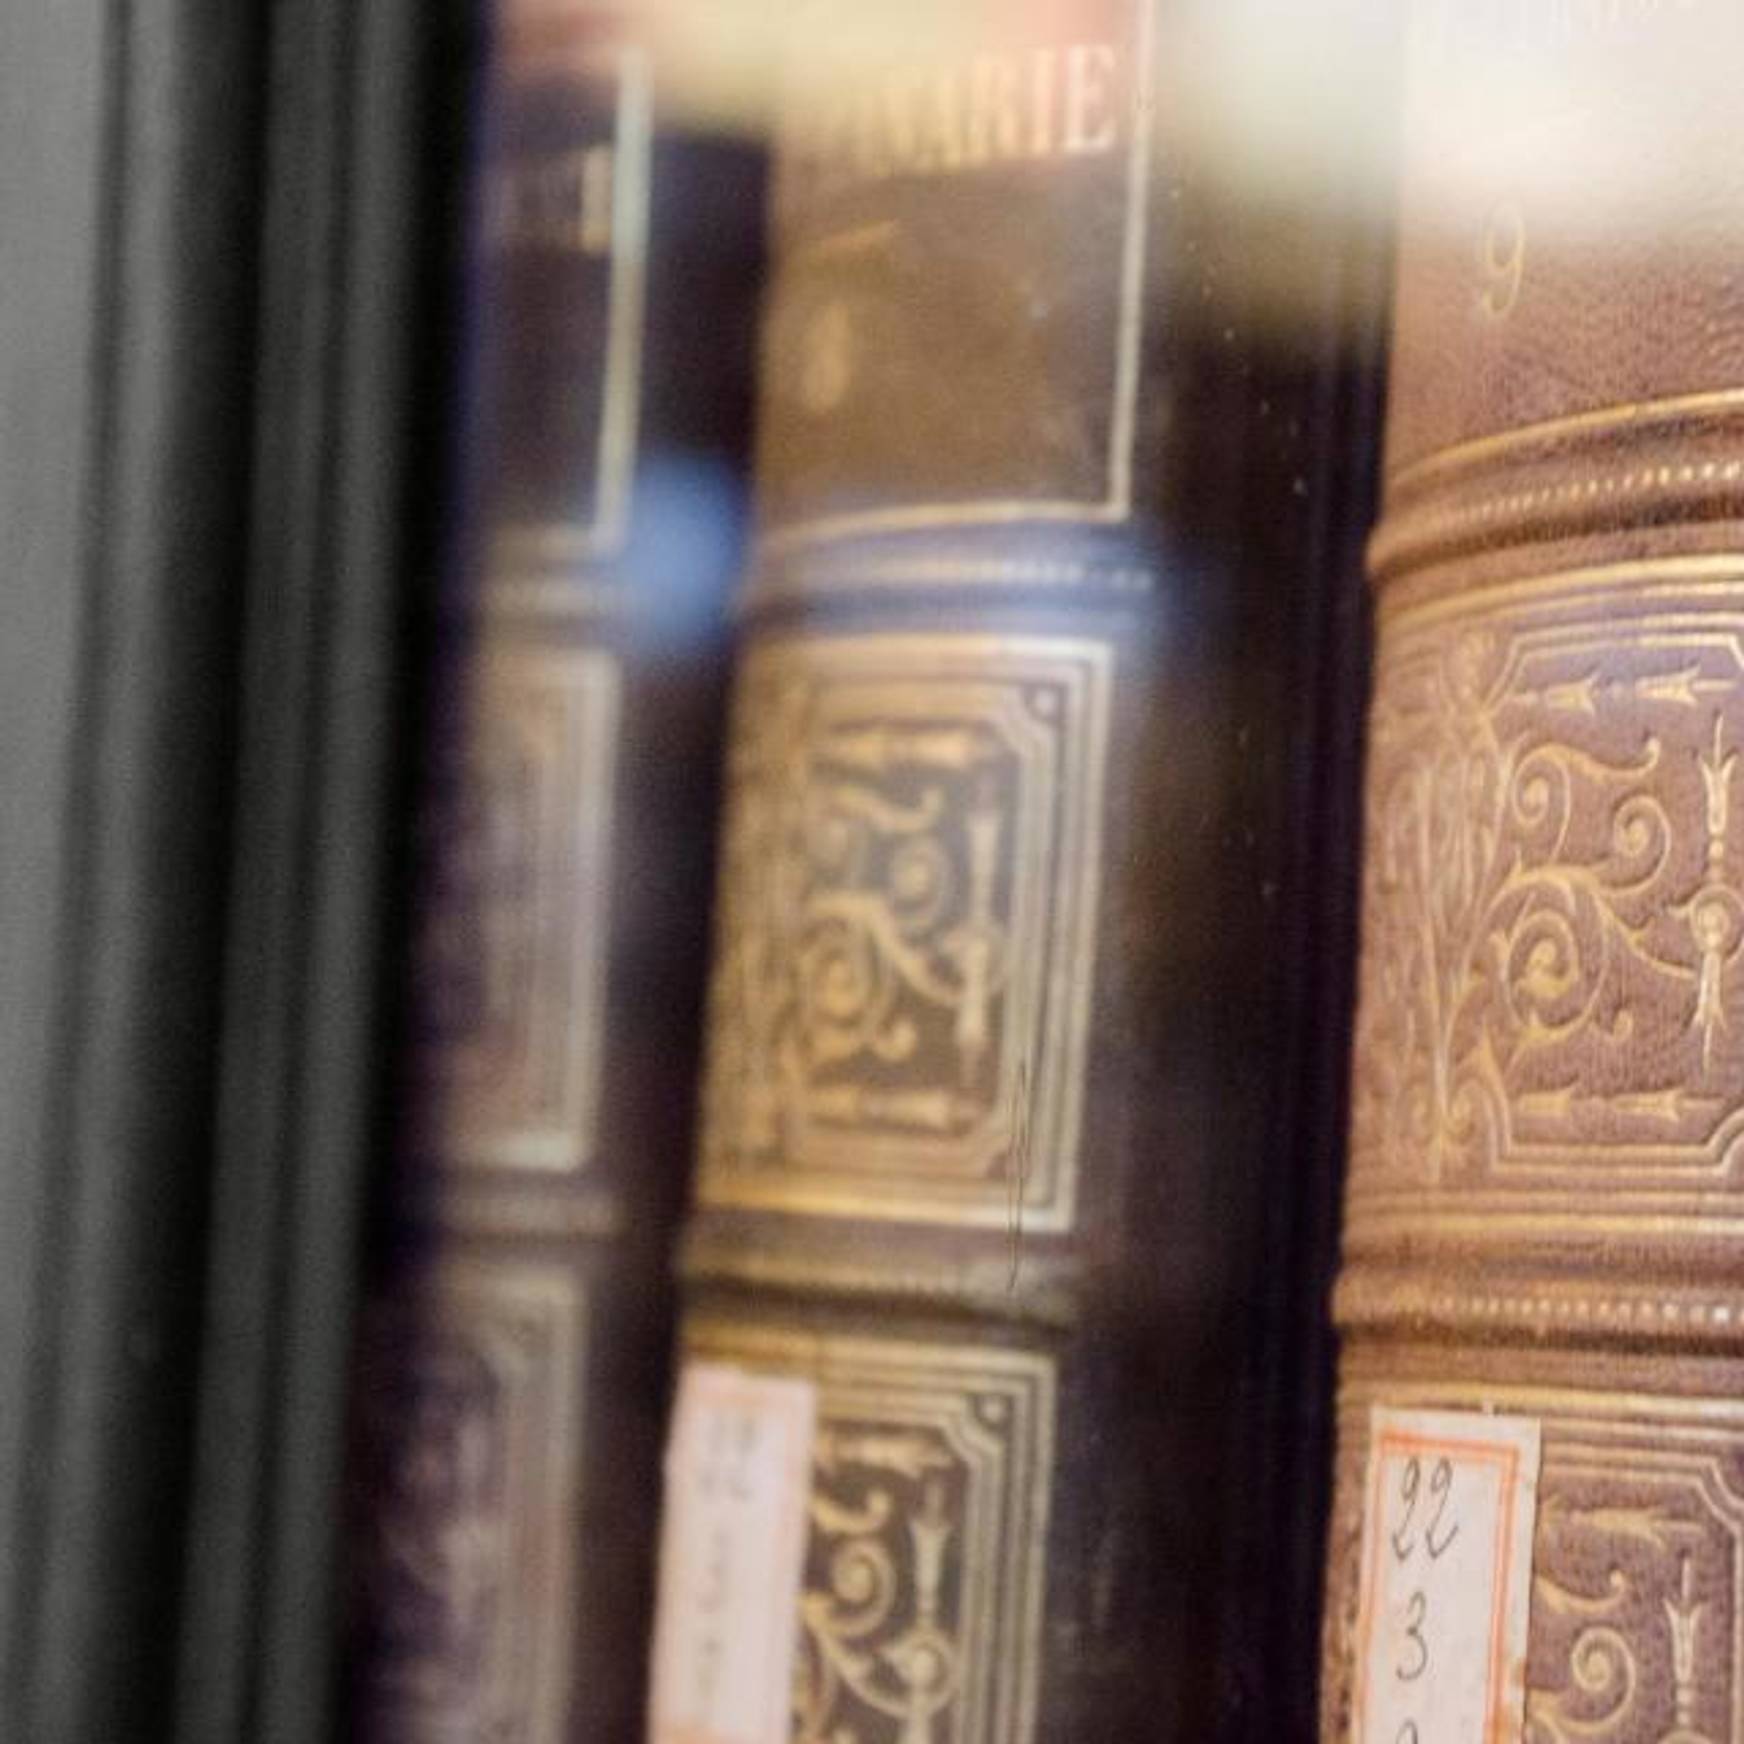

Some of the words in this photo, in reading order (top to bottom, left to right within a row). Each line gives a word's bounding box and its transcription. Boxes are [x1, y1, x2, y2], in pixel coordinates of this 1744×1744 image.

[1482, 202, 1526, 320] 9
[1392, 1455, 1458, 1560] 22
[1396, 1591, 1428, 1681] 3
